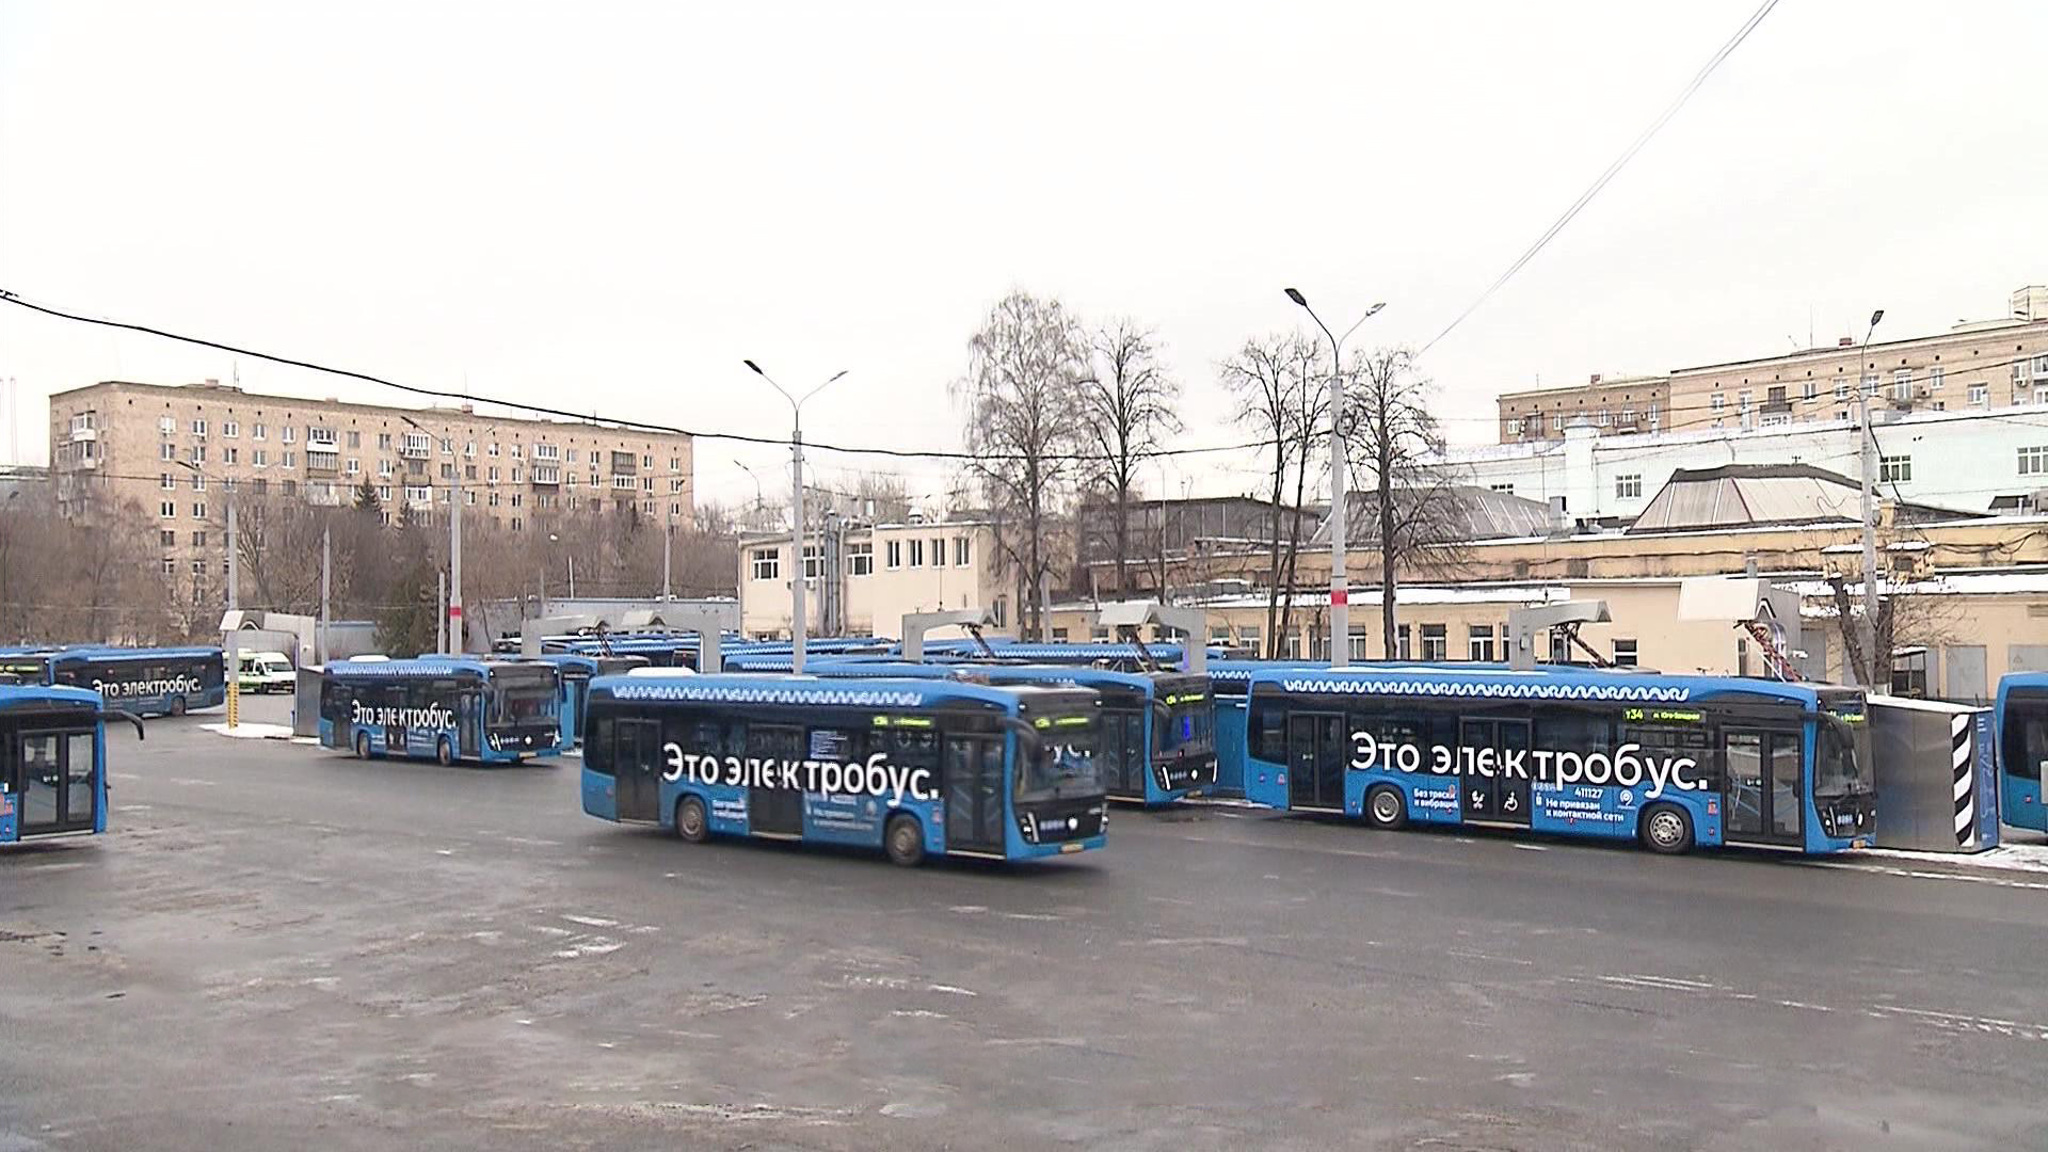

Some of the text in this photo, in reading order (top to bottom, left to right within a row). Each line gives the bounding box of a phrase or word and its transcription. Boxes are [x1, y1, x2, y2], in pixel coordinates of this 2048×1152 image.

[92, 674, 202, 697] Это электробус.
[351, 699, 456, 734] Это электробус.
[1350, 731, 1709, 798] Это электробус.
[663, 742, 940, 808] Это электробус.
[1413, 787, 1428, 799] Без
[1574, 786, 1604, 799] 411127
[1545, 798, 1601, 810] Не привязан
[1545, 809, 1624, 822] к контактной сети
